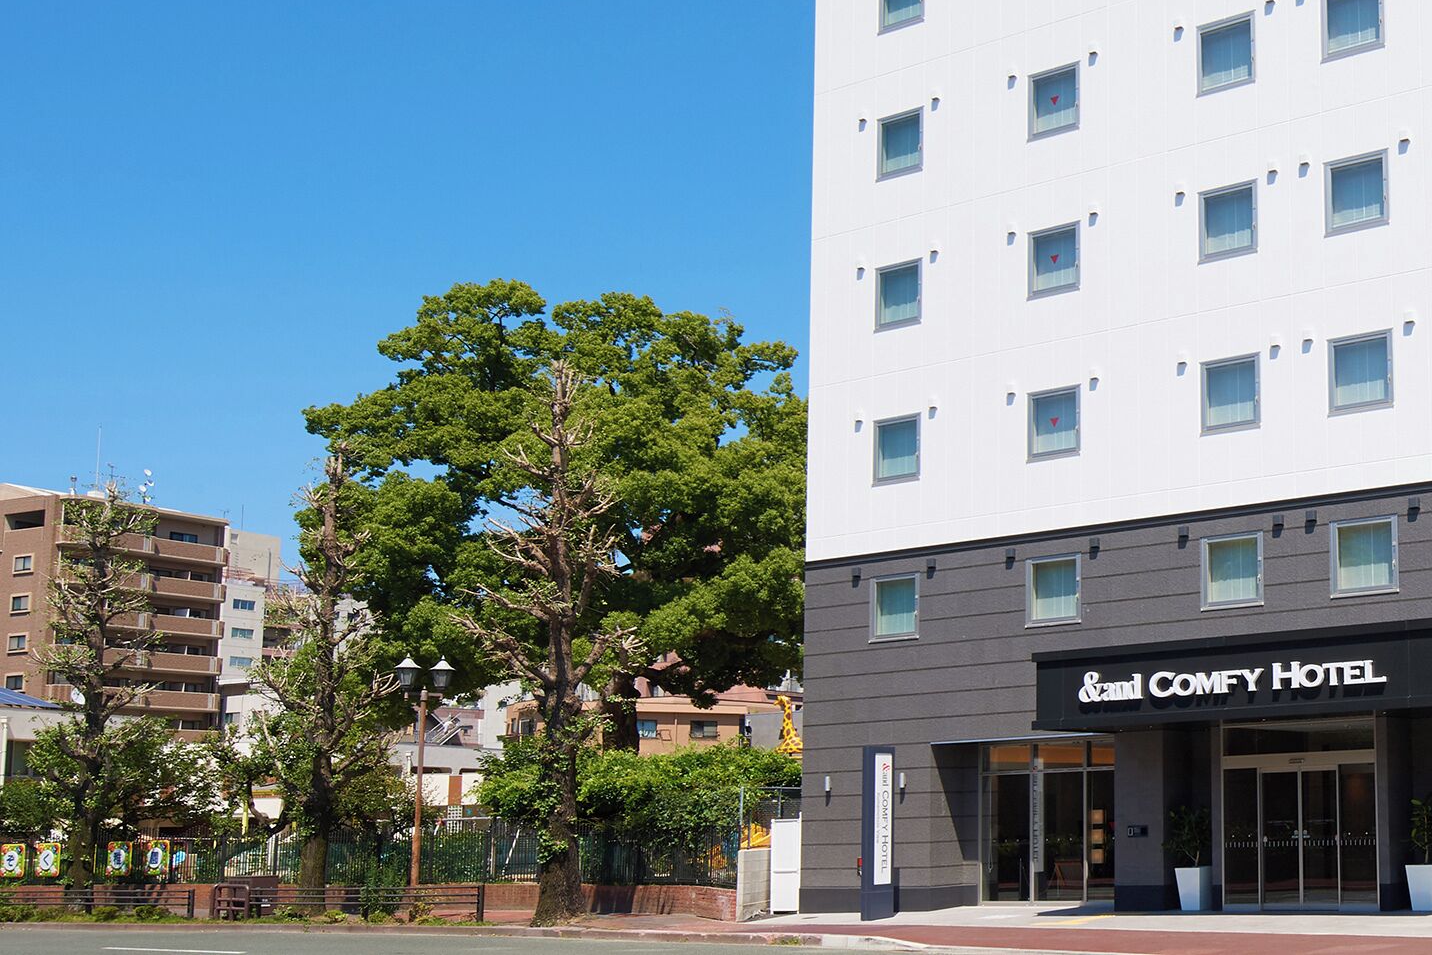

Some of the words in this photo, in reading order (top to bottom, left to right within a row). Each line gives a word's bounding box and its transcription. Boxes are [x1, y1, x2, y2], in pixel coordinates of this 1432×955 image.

[1078, 671, 1143, 703] &and
[1149, 668, 1264, 698] COMFY
[1272, 660, 1387, 690] HOTEL
[42, 853, 49, 866] く
